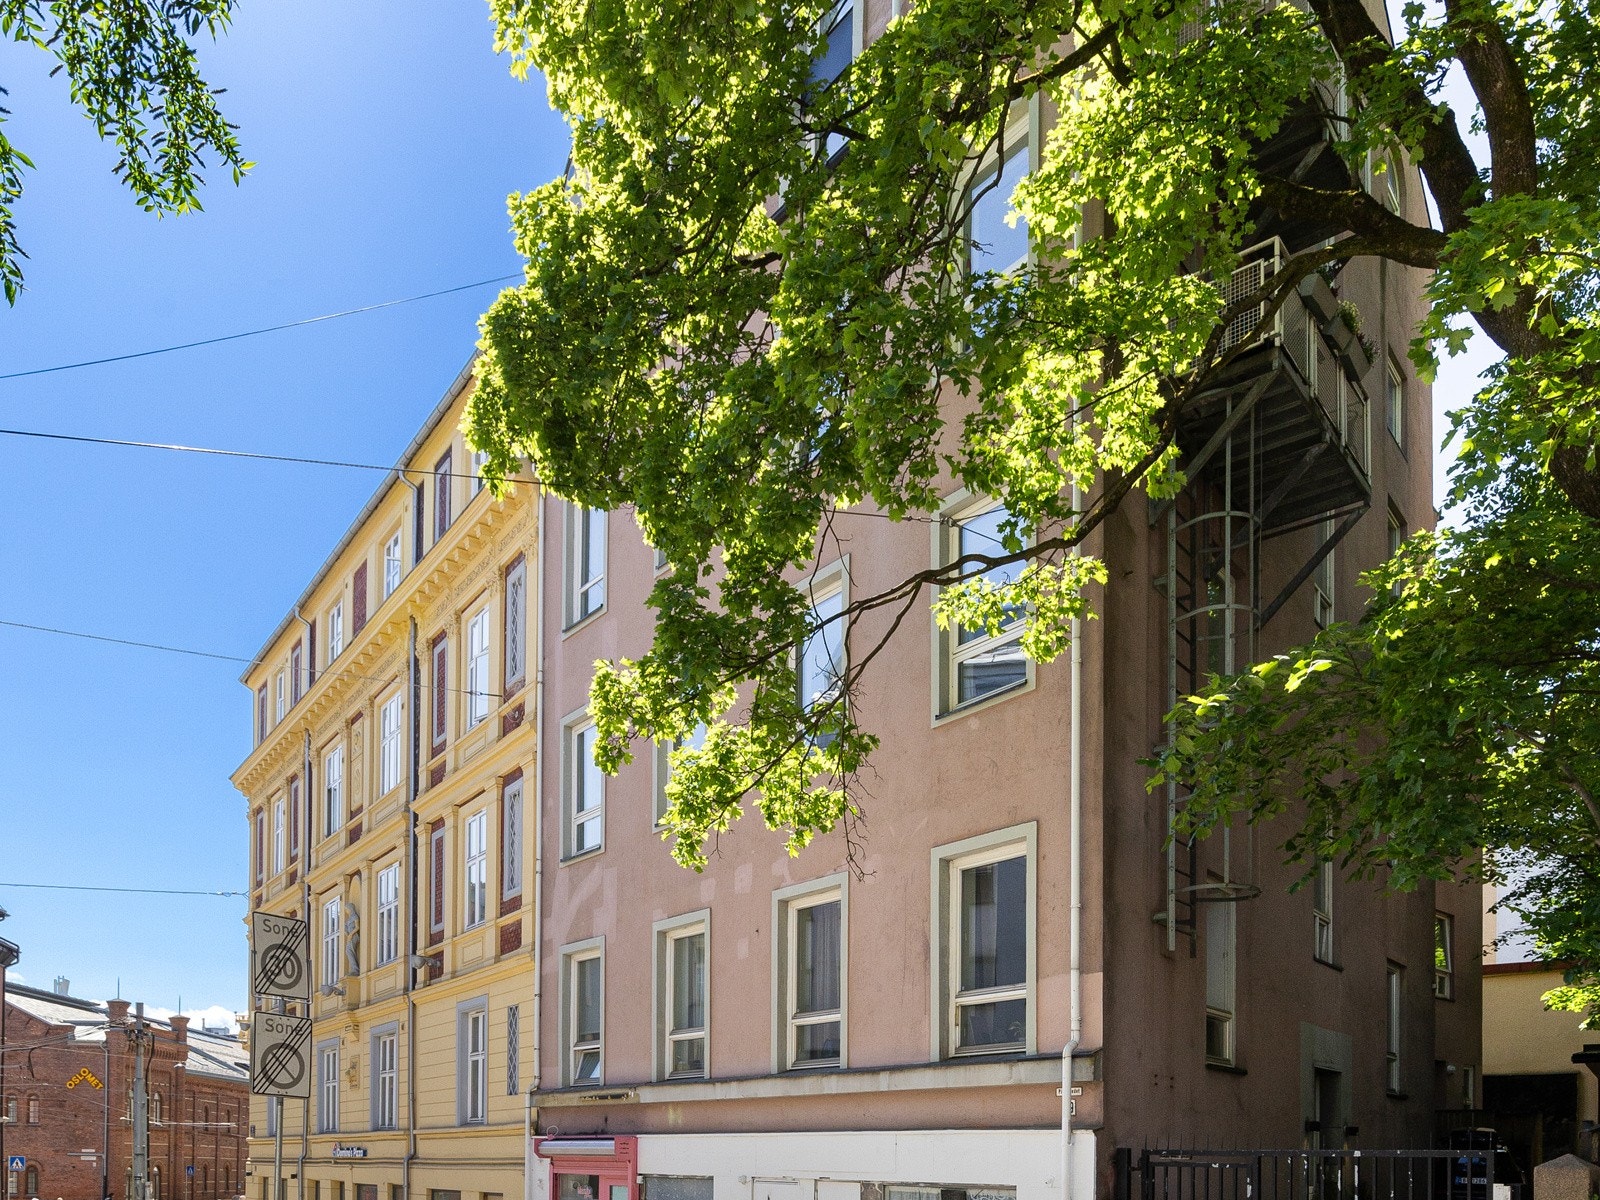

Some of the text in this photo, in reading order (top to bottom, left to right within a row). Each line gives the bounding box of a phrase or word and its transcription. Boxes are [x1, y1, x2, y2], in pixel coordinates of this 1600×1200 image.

[262, 918, 299, 938] Sone
[264, 1018, 303, 1036] Sone
[66, 1067, 104, 1090] OSLOMET
